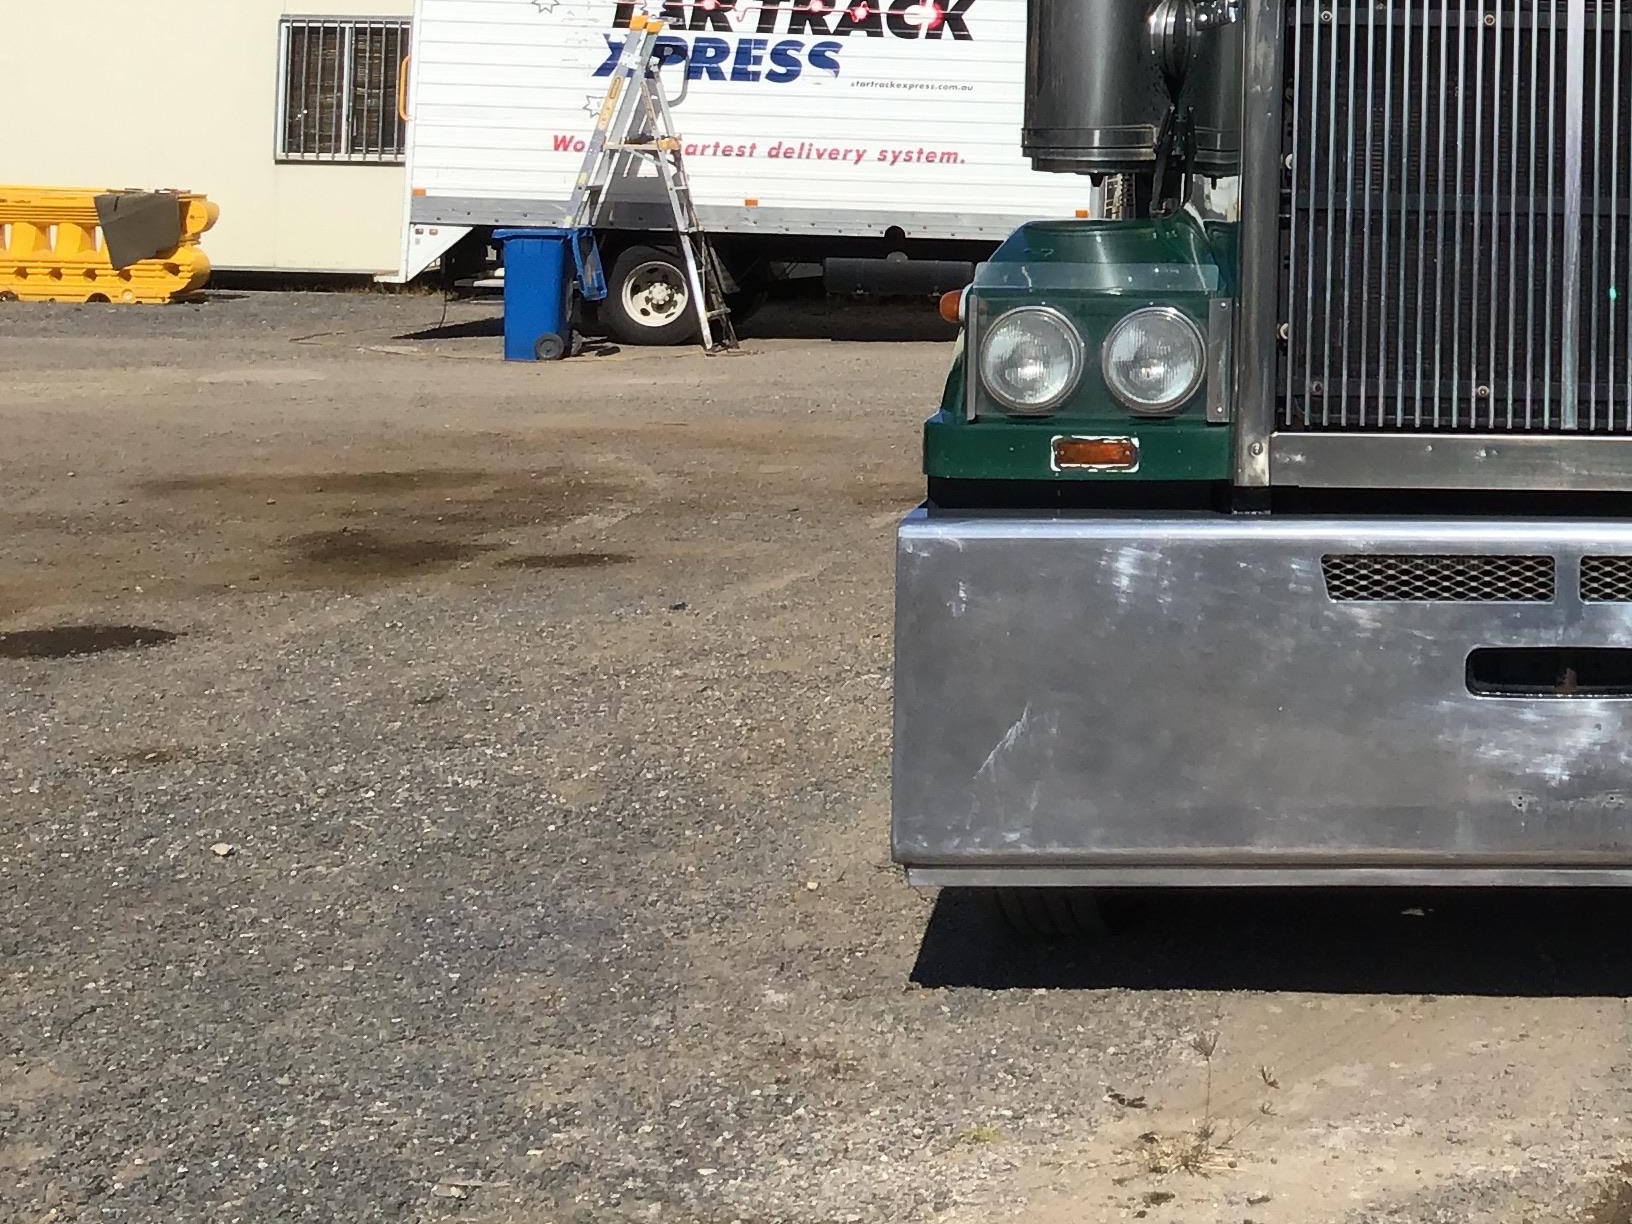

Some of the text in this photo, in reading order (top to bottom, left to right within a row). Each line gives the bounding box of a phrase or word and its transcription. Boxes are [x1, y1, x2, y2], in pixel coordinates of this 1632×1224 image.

[850, 75, 974, 91] startrackexpress.com.au
[767, 141, 867, 165] delivery
[877, 147, 966, 166] system.
